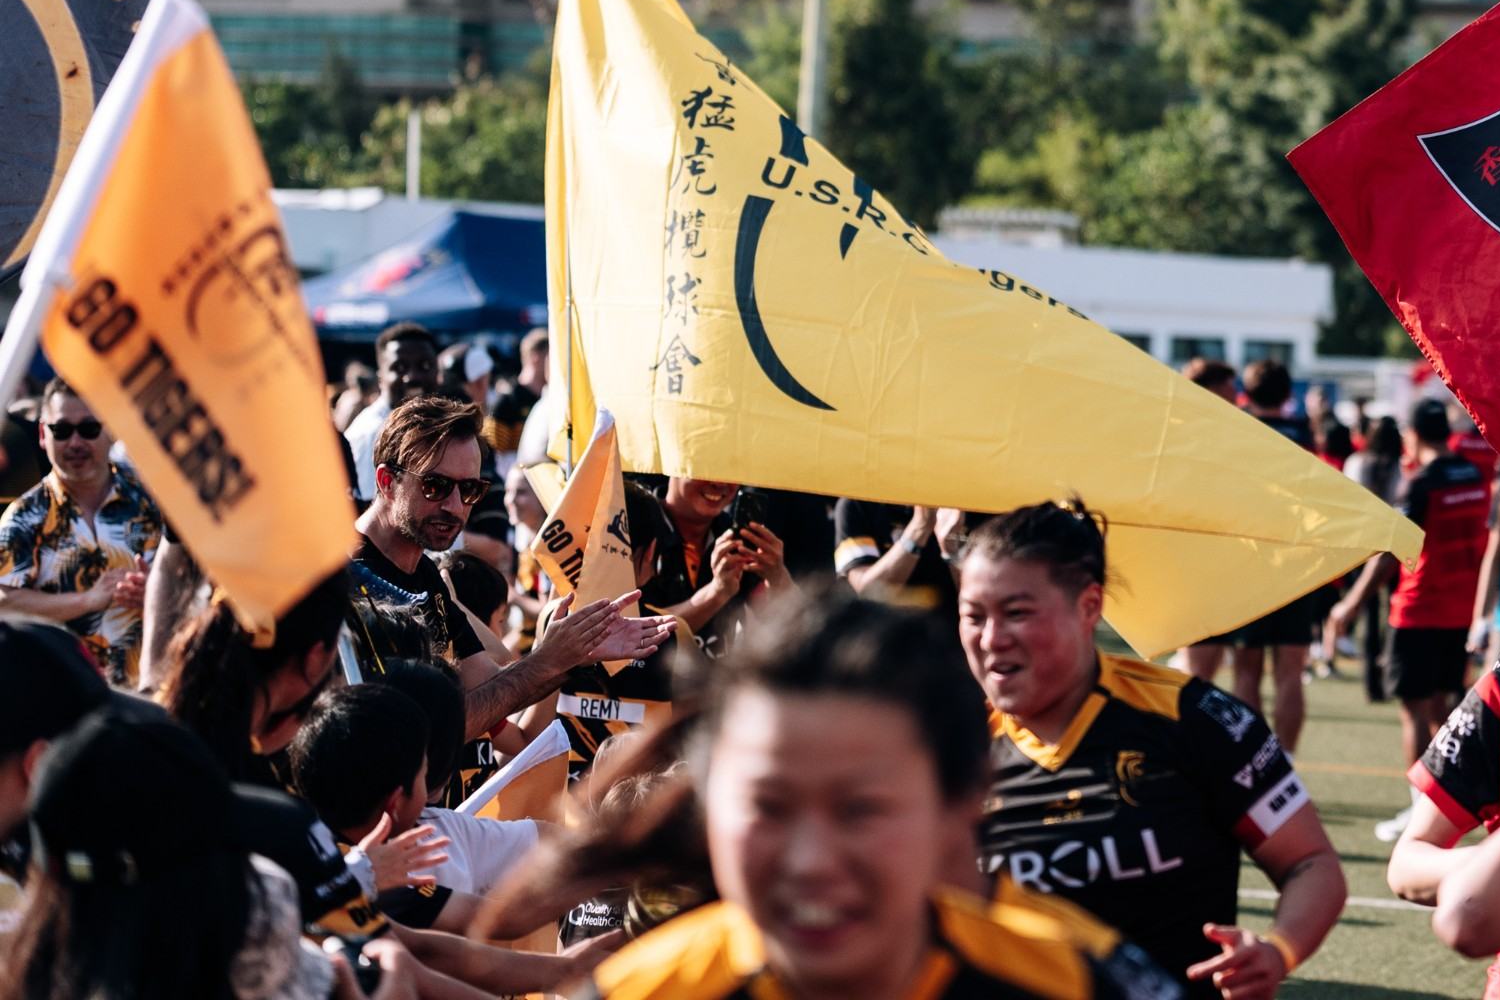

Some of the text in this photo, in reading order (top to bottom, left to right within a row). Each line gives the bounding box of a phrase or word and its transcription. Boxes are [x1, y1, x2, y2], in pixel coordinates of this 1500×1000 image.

[65, 276, 141, 355] GO
[541, 518, 574, 554] GO
[580, 698, 621, 721] REMY
